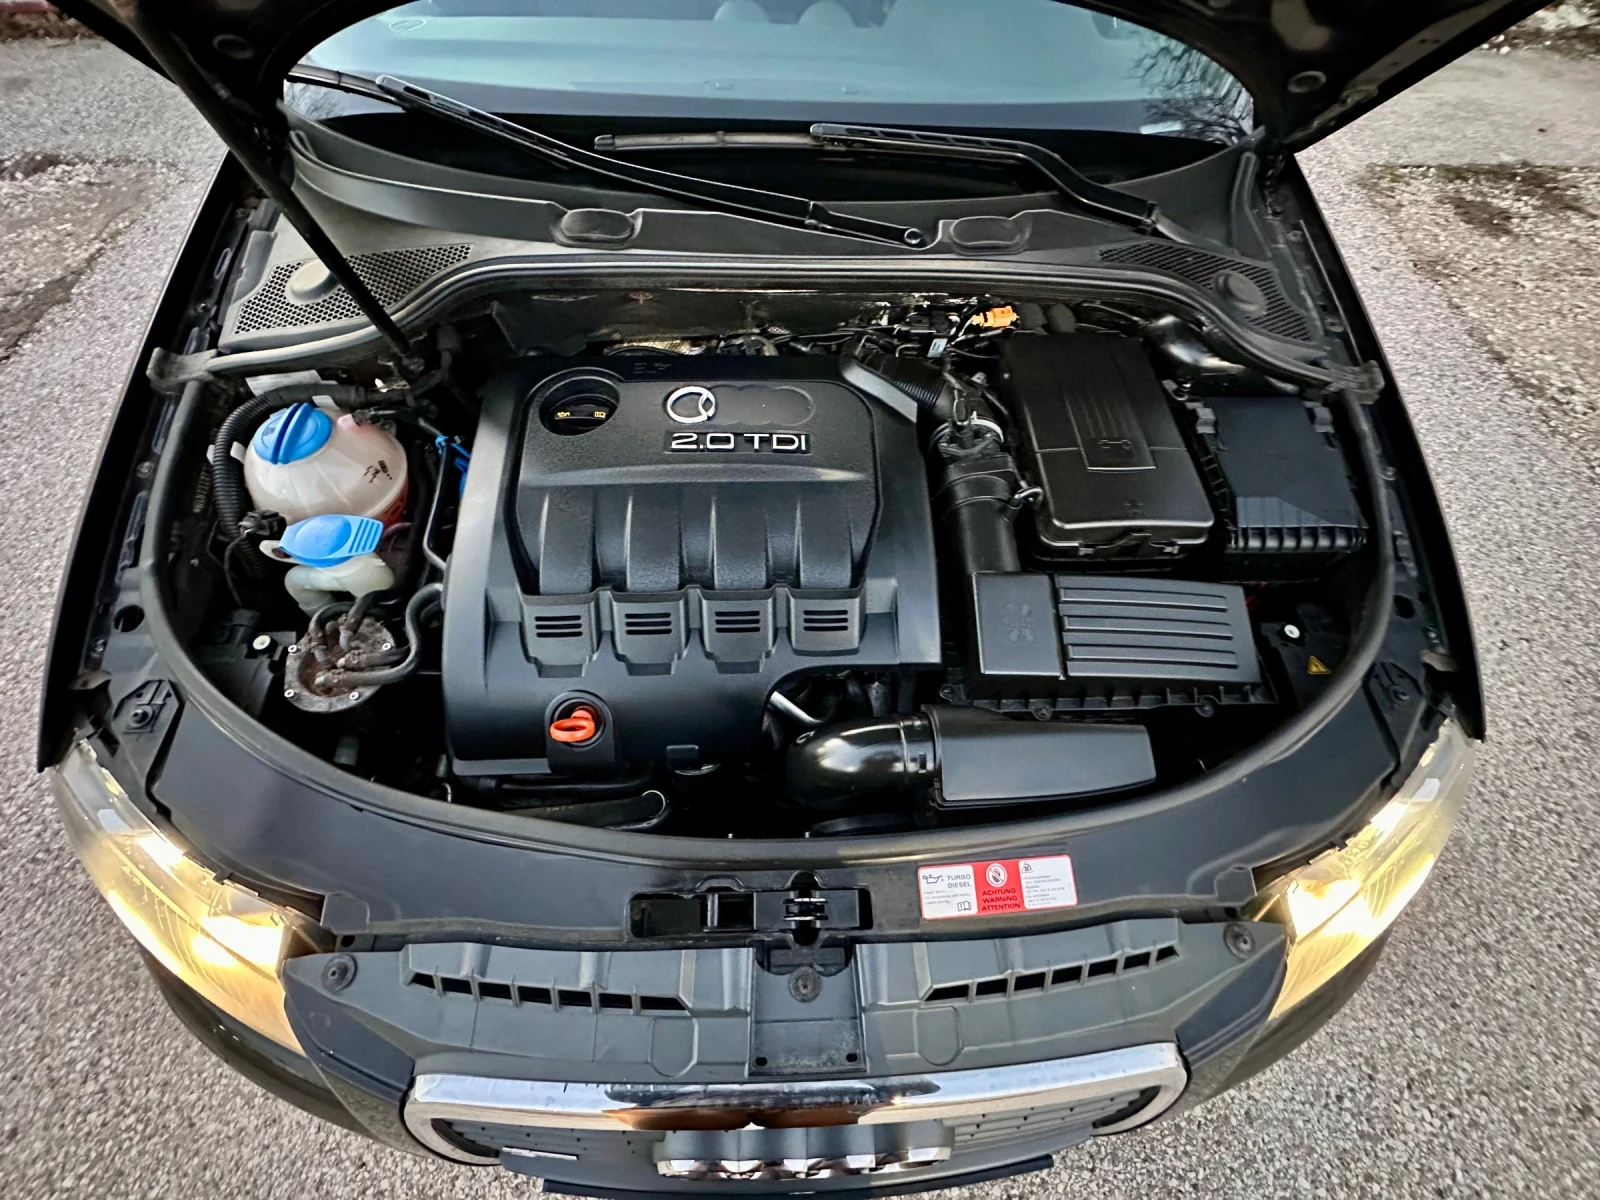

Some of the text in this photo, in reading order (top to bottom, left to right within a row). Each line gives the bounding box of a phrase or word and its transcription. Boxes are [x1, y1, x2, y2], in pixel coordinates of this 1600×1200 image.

[671, 432, 807, 451] 2.0 TDI
[946, 873, 971, 881] TURBO
[982, 887, 1017, 896] ACHTUNG
[982, 895, 1018, 904] WARNING
[982, 903, 1021, 912] ATTENTION
